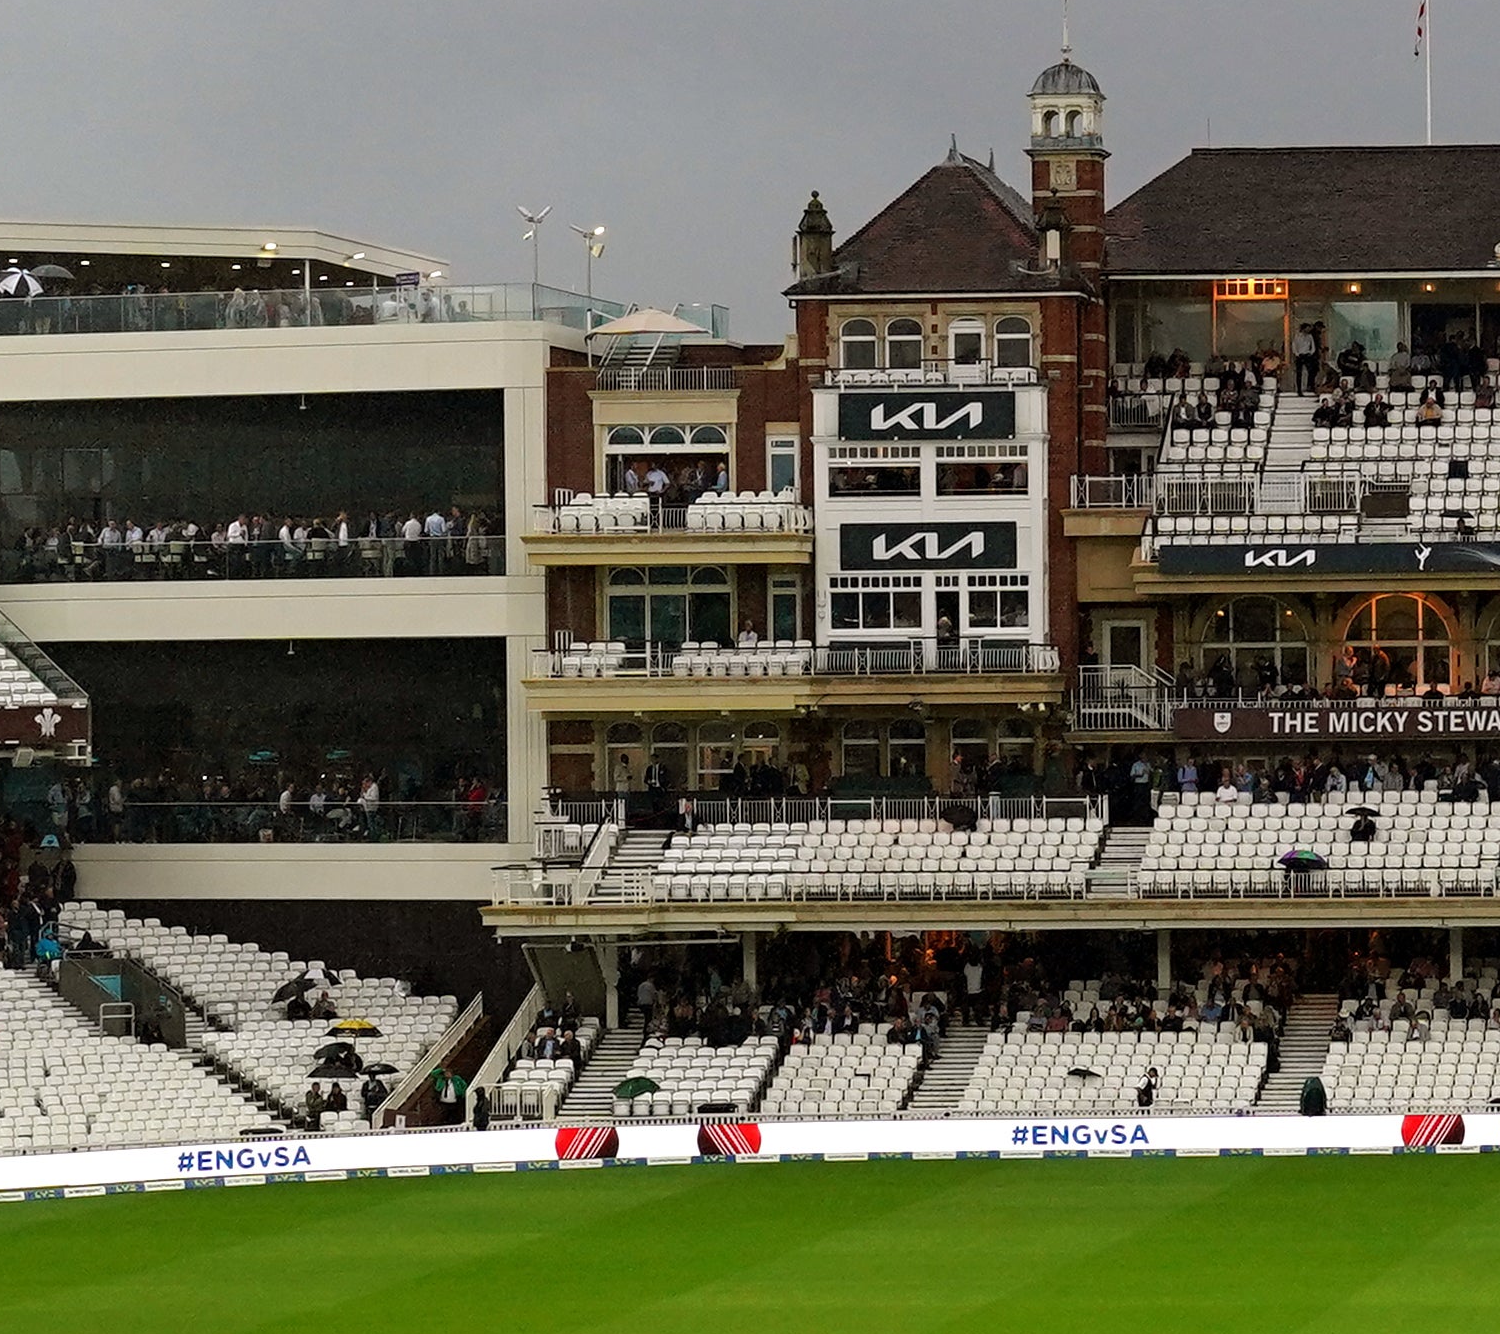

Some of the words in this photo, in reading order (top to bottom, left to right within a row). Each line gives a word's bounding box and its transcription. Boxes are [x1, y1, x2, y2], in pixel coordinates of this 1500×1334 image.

[1269, 712, 1320, 735] THE
[1328, 711, 1409, 735] MICKY
[1011, 1124, 1149, 1145] #ENGvSA
[177, 1145, 311, 1172] #ENGvSA
